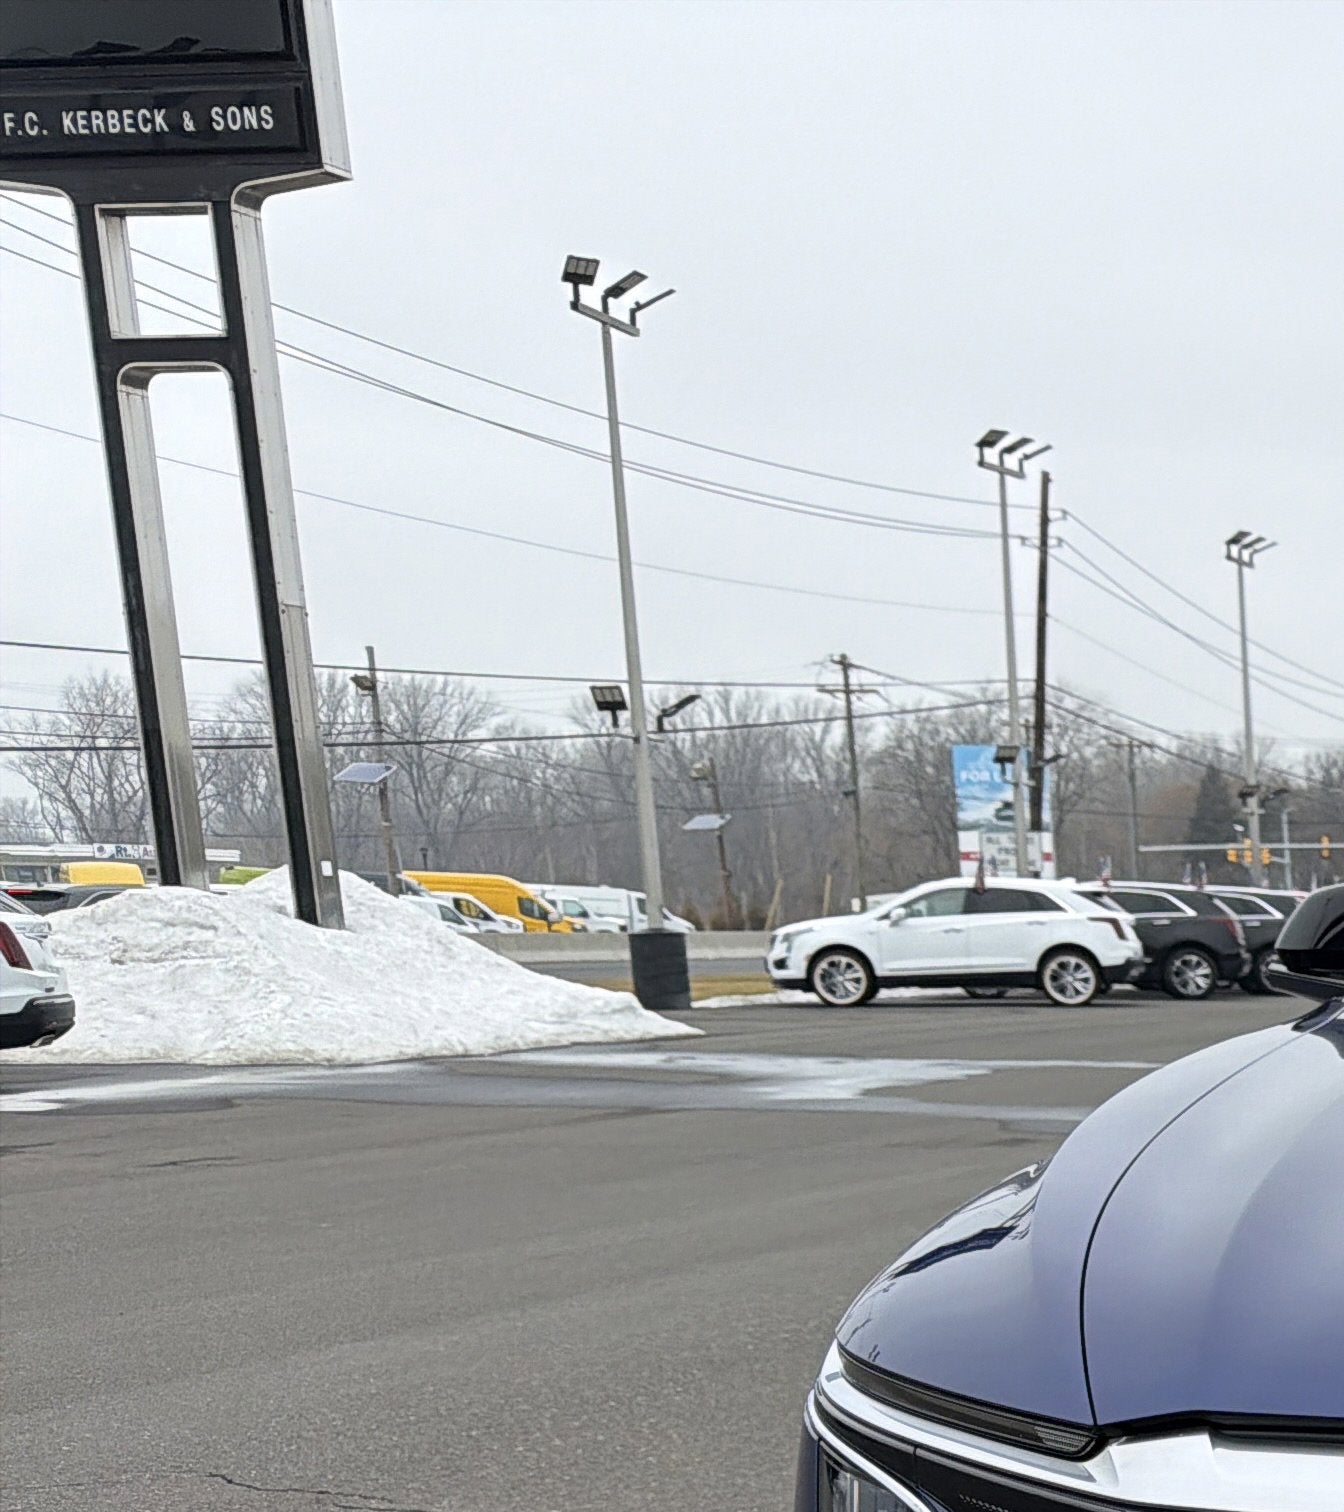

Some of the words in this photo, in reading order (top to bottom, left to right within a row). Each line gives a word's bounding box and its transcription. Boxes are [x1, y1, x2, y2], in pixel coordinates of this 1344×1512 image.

[3, 111, 49, 136] F.C.
[62, 108, 170, 135] KERBECK
[182, 110, 197, 132] &
[210, 105, 274, 131] SONS
